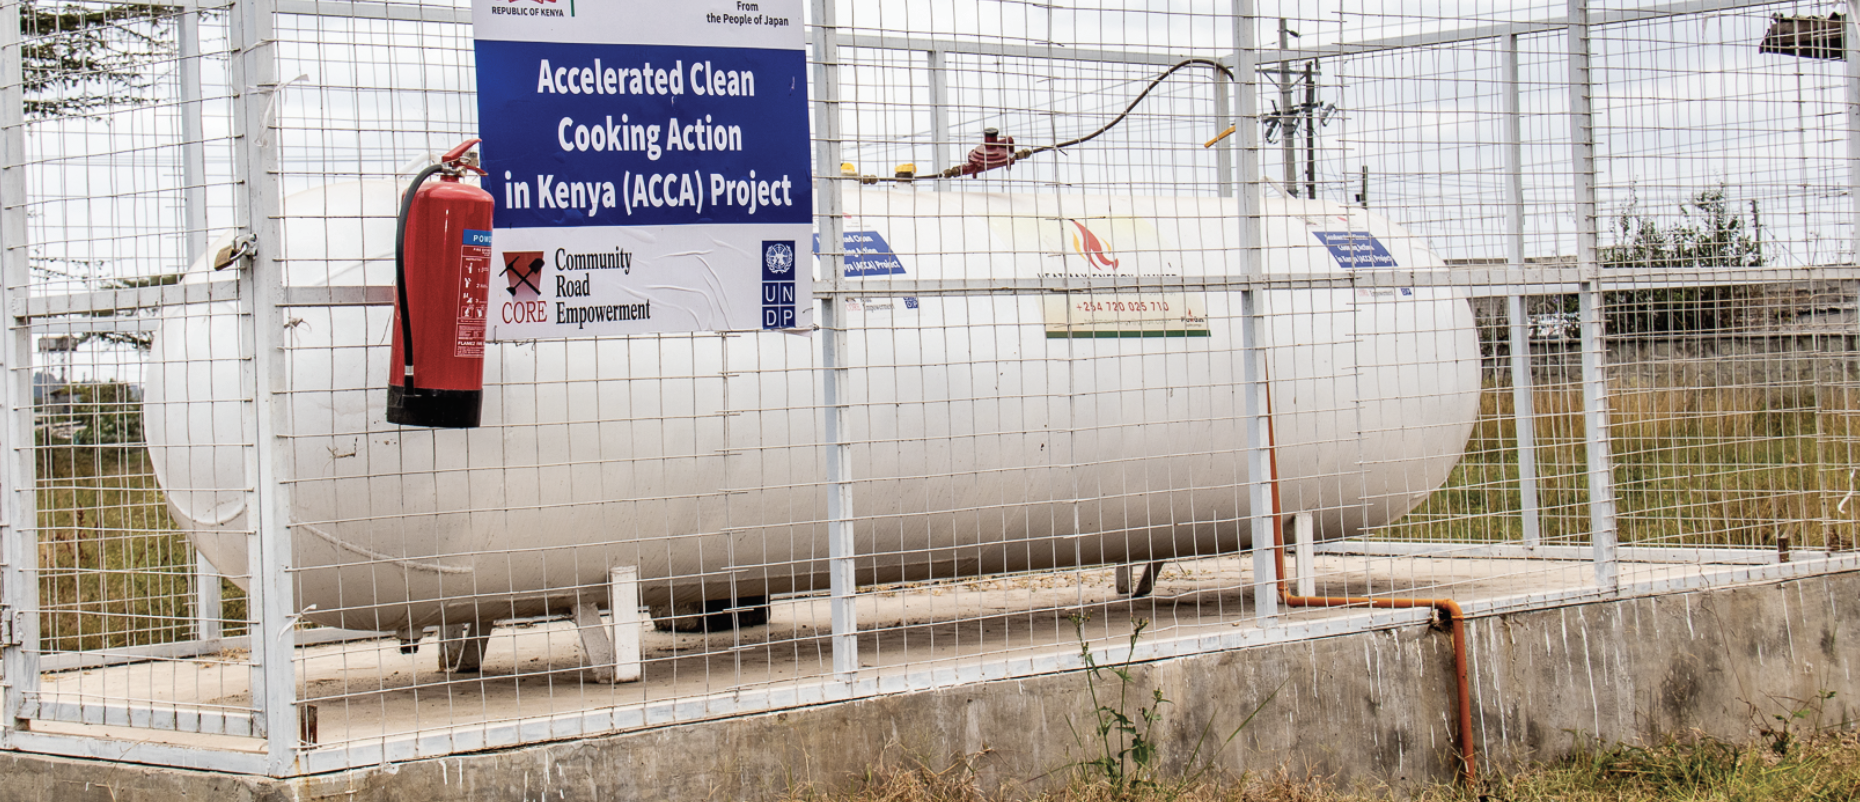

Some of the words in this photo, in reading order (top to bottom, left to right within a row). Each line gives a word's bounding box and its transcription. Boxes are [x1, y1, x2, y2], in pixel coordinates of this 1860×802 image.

[492, 6, 528, 16] REPUBLIC
[529, 8, 539, 16] OF
[540, 9, 564, 17] KENYA
[737, 1, 759, 12] From
[706, 13, 721, 24] the
[723, 13, 752, 26] People
[753, 14, 763, 25] of
[763, 15, 789, 27] Japan
[537, 58, 684, 95] Accelerated
[690, 60, 755, 97] Clean
[558, 113, 661, 161] Cooking
[666, 114, 742, 152] Action
[505, 170, 530, 209] in
[537, 174, 616, 218] Kenya
[623, 170, 703, 216] (ACCA)
[710, 170, 793, 215] Project
[555, 246, 632, 275] Community
[555, 273, 590, 298] Road
[502, 301, 548, 324] CORE
[555, 299, 651, 329] Empowerment
[1076, 301, 1103, 312] +254
[1106, 301, 1125, 312] 720
[1128, 301, 1147, 312] 025
